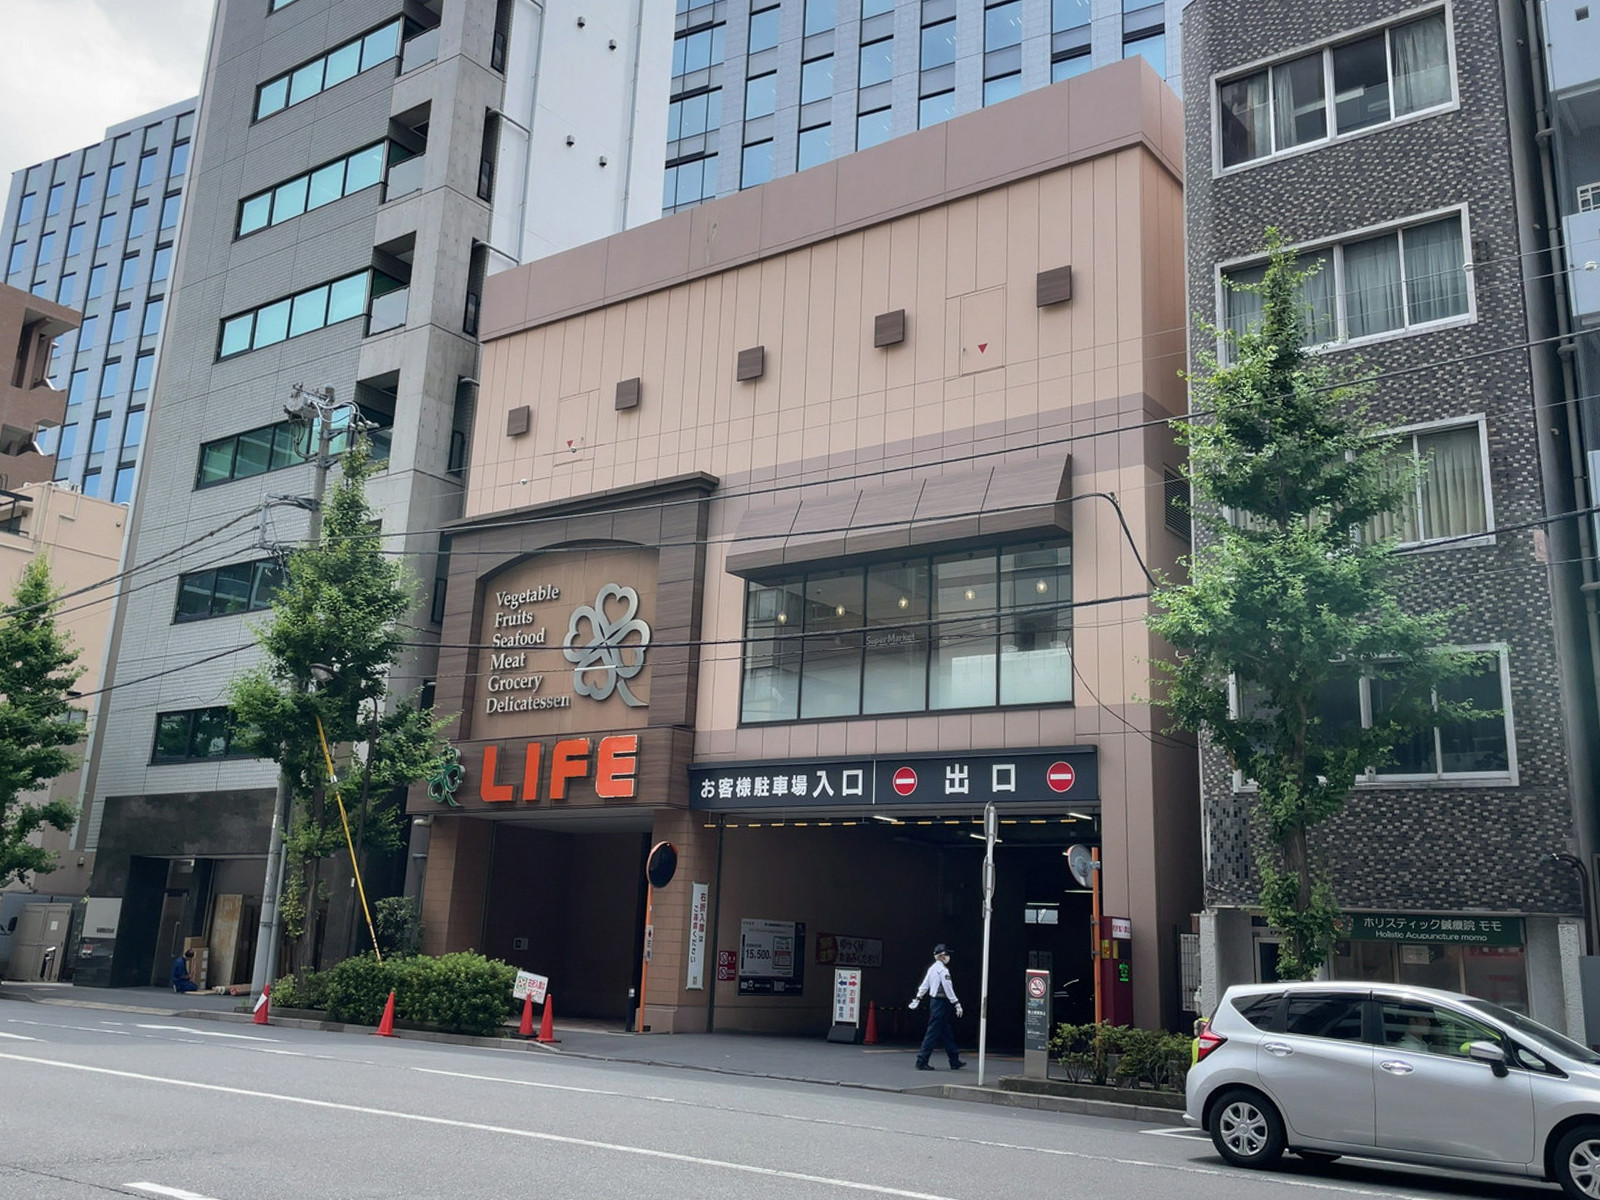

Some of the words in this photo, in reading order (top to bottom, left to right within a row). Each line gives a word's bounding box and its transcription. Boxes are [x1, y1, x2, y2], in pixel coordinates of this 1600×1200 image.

[496, 584, 560, 610] Vegetable
[494, 610, 534, 628] Fruits
[492, 627, 546, 647] Seafood
[490, 652, 526, 670] Meat
[487, 675, 543, 693] Grocery
[486, 695, 571, 714] Delicatessen
[480, 734, 638, 803] LIFE
[700, 769, 863, 799] お客様駐車場入口
[945, 763, 1016, 794] 出口
[1375, 930, 1404, 939] Holistic
[1405, 931, 1459, 941] Acupuncture
[1479, 920, 1502, 932] モモ
